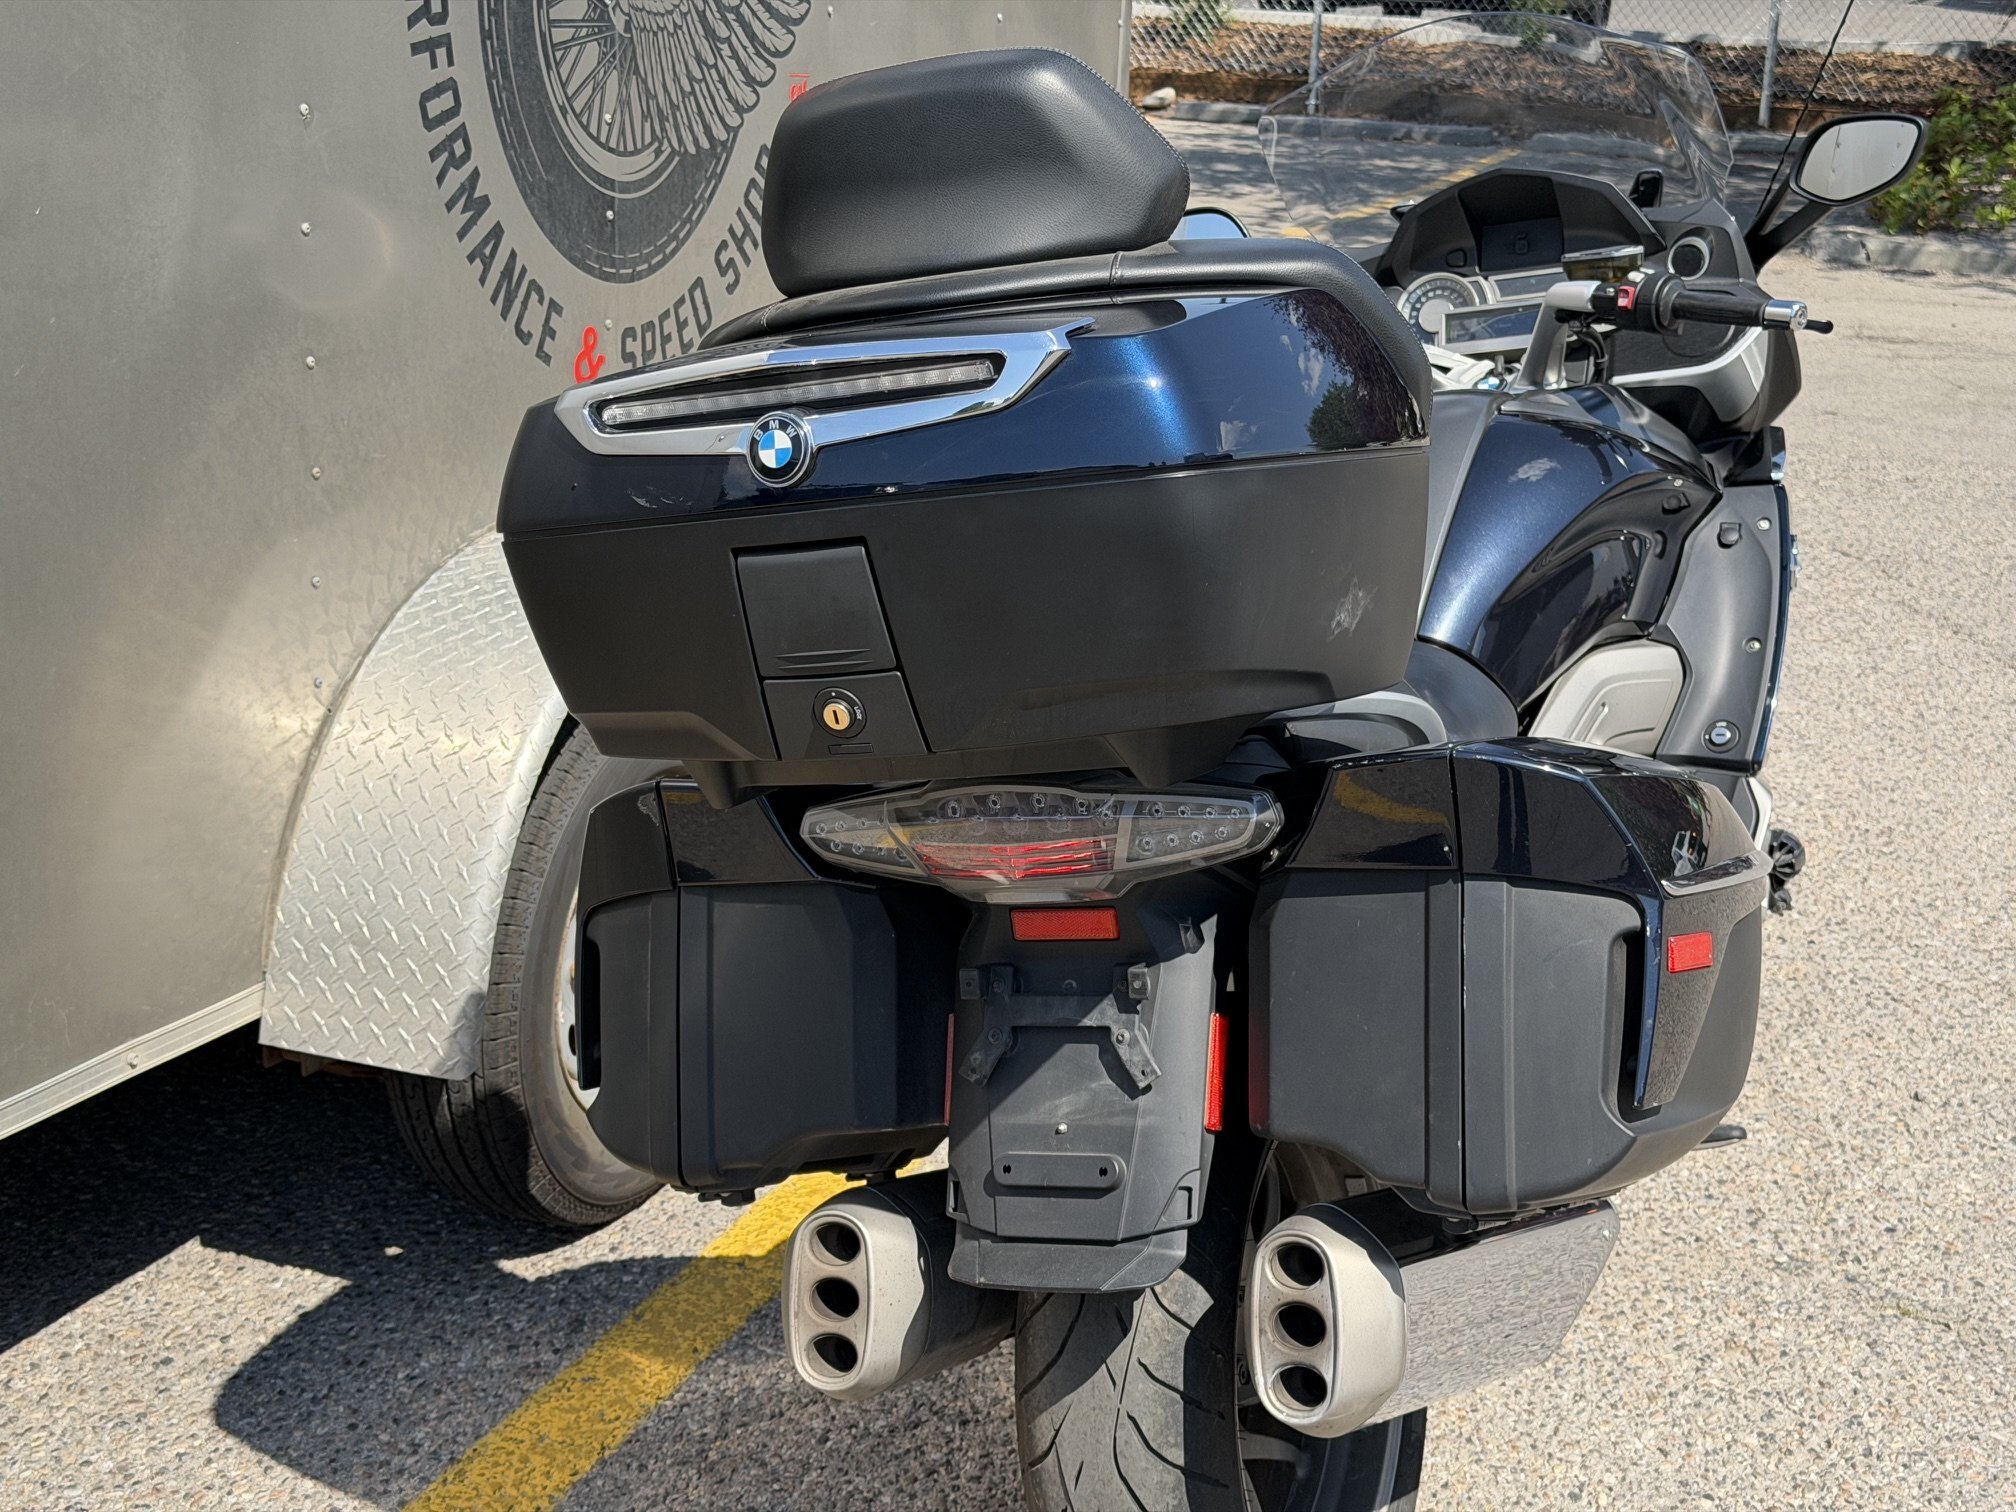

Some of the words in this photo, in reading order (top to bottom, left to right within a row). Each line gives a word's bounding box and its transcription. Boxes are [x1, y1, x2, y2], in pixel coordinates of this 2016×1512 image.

[574, 326, 605, 384] &
[621, 276, 713, 368] SPEED
[753, 419, 798, 441] BMW
